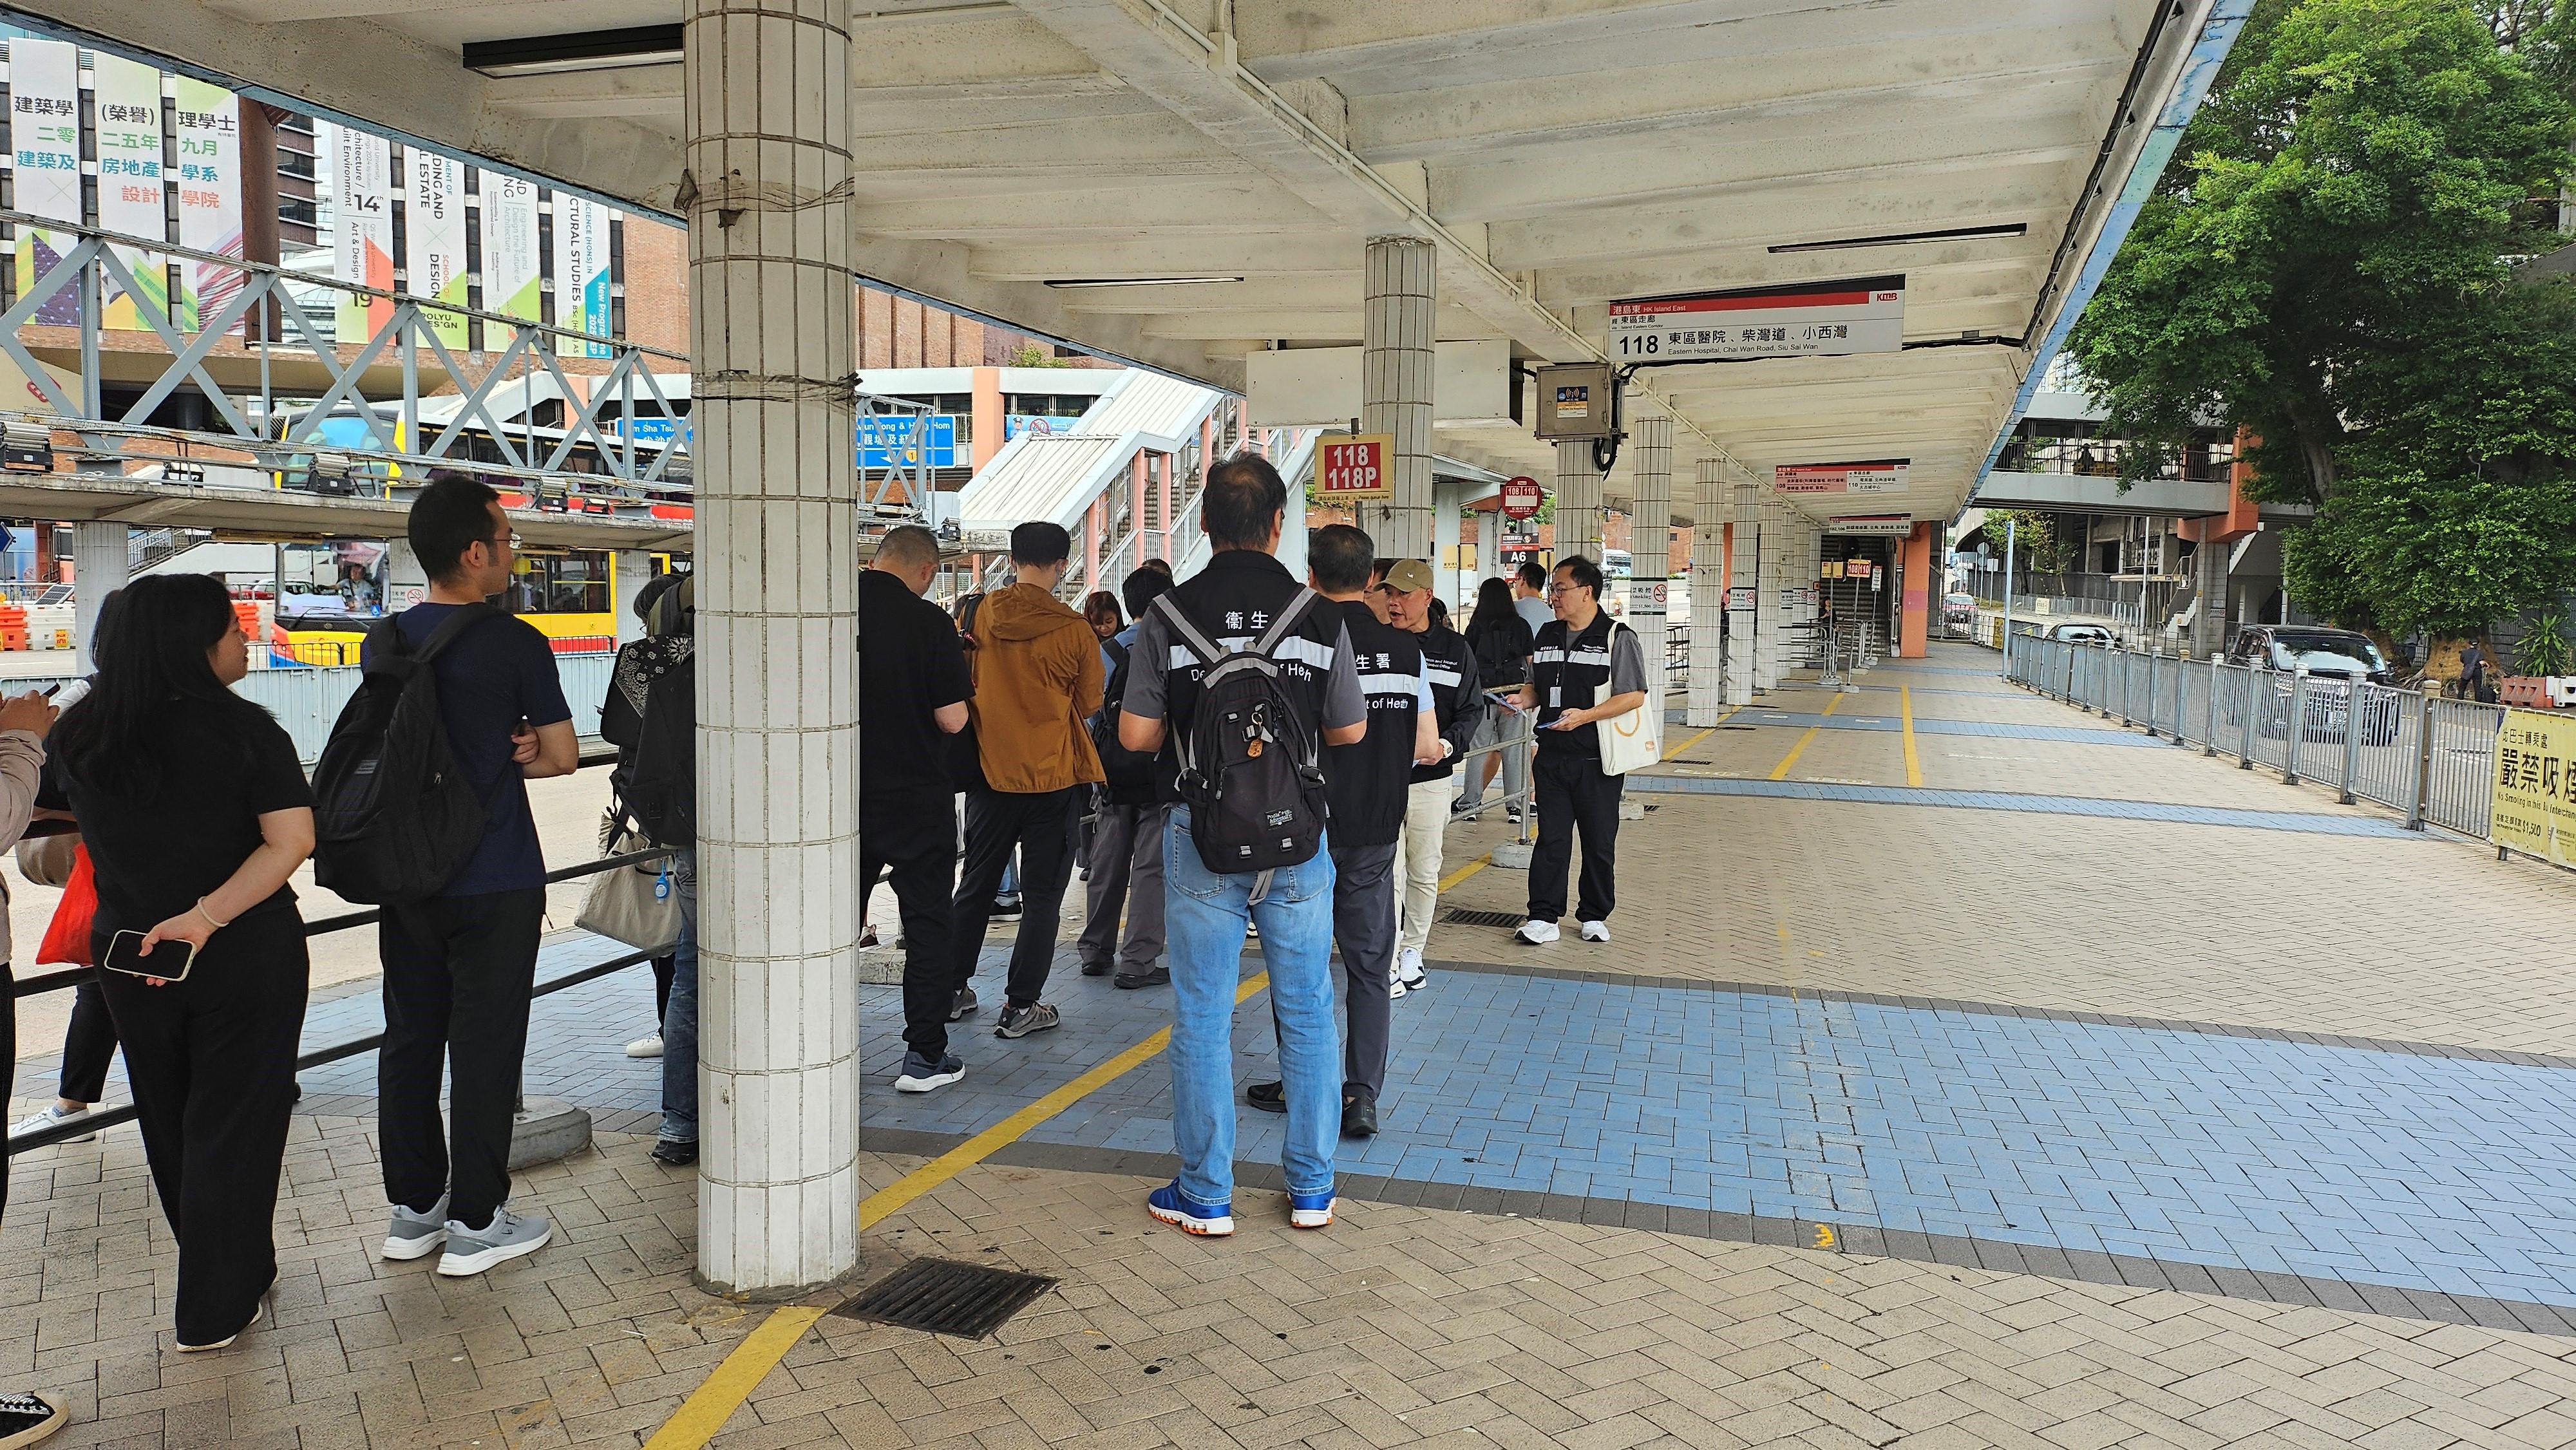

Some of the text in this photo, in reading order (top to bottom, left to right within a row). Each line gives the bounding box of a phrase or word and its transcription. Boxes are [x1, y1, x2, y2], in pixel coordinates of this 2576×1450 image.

[15, 96, 73, 116] 建築學
[102, 104, 155, 126] (榮譽)
[178, 111, 235, 131] 理學士
[37, 127, 75, 143] 二零
[102, 132, 159, 150] 二五年
[182, 137, 217, 156] 九月
[17, 151, 76, 170] 建築及
[102, 158, 160, 178] 房地產
[181, 164, 218, 182] 學系
[344, 146, 352, 207] Environment
[121, 185, 160, 203] 設計
[420, 164, 430, 209] ESTATE
[446, 184, 452, 196] OF
[181, 190, 220, 208] 學院
[354, 194, 380, 212] 14
[433, 193, 443, 220] AND
[430, 254, 440, 299] DESIGN
[571, 250, 581, 301] STUDIES
[598, 282, 606, 297] New
[1877, 292, 1897, 301] KMB
[1613, 305, 1641, 315] 港島東
[1621, 315, 1655, 324] 東區走廊
[1619, 335, 1658, 355] 118
[1694, 347, 1721, 355] Hospital,
[1757, 344, 1776, 353] Road,
[643, 424, 658, 433] Sha
[1334, 445, 1368, 467] 118
[1329, 467, 1377, 489] 118P
[1508, 487, 1535, 496] 108 110
[1511, 551, 1526, 562] A6
[1848, 564, 1870, 574] 108 110
[1372, 697, 1384, 708] of
